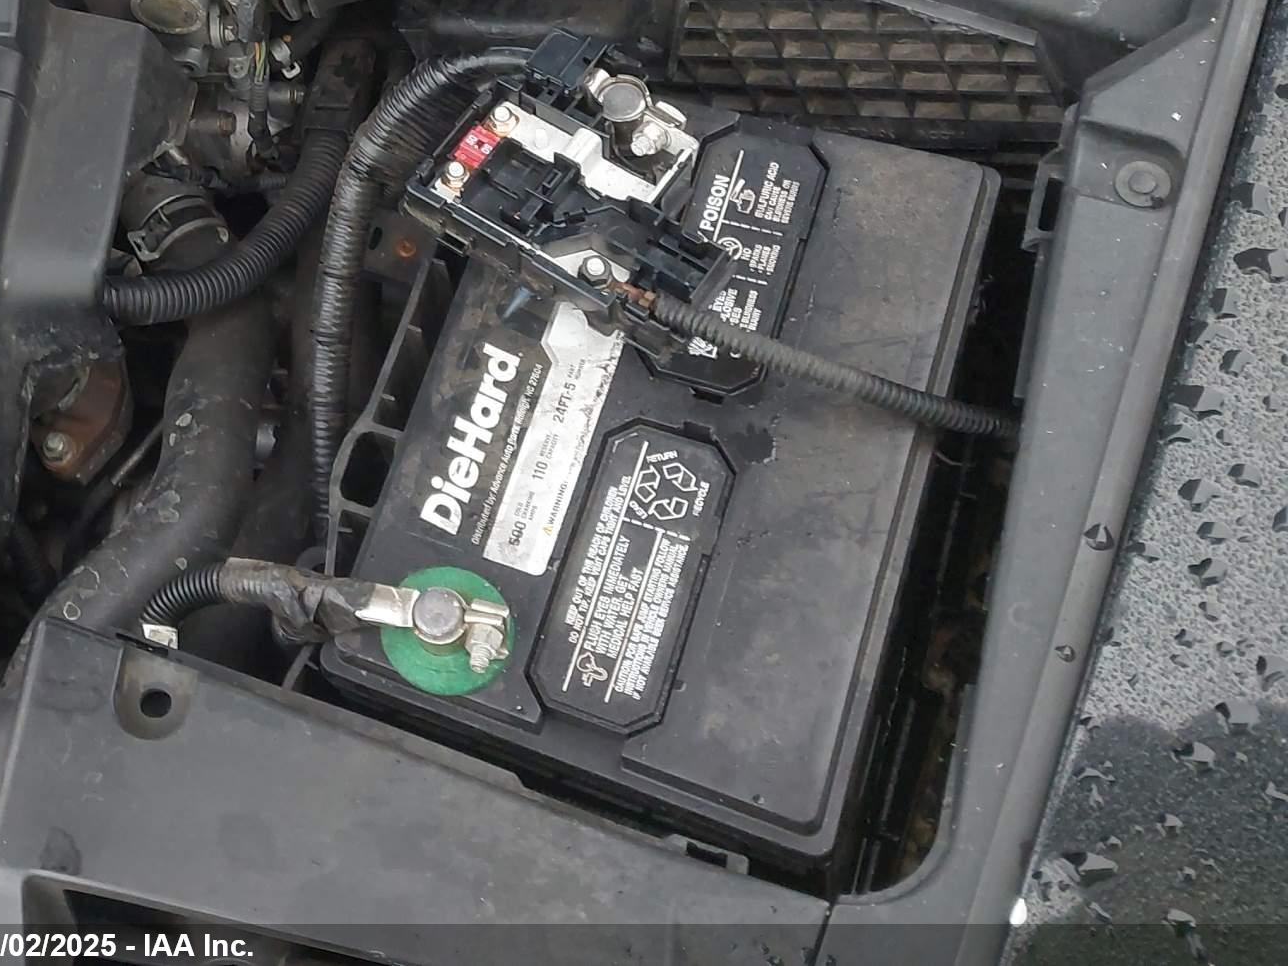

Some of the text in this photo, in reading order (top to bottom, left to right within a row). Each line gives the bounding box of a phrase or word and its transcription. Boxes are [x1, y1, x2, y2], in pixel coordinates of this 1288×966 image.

[766, 162, 779, 181] ACID
[741, 248, 752, 260] NO
[420, 343, 522, 535] DieHard
[471, 503, 491, 544] Distributed
[490, 462, 507, 493] Advance
[501, 444, 514, 463] Auto
[524, 385, 534, 396] NC
[532, 461, 548, 479] 110
[617, 476, 631, 496] LEVEL
[600, 486, 618, 521] CHILDREN
[612, 497, 624, 513] AND
[692, 481, 709, 516] RECYCLE
[604, 512, 618, 534] TIGHT
[587, 534, 603, 559] REACH
[597, 536, 610, 555] CAPS
[654, 538, 670, 568] FOLLOW
[581, 558, 594, 574] THE
[590, 556, 603, 575] VENT
[578, 575, 588, 588] OF
[584, 576, 596, 596] KEEP
[643, 568, 662, 602] STARTING
[572, 587, 584, 604] OUT
[583, 535, 630, 651] FLUSH EYES IMMEDIATELY
[657, 587, 675, 617] SERVICE
[565, 604, 578, 625] KEEP
[573, 613, 584, 631] NOT
[595, 630, 612, 654] WITH
[615, 574, 629, 593] GET
[606, 567, 643, 658] MEDICAL HELP FAST
[637, 602, 652, 625] JUMP
[568, 631, 579, 643] DO
[630, 623, 644, 642] SAFE
[621, 643, 650, 695] INSTRUCTIONS
[642, 604, 662, 634] VEHICLE
[625, 642, 639, 659] FOR
[639, 636, 659, 675] AVAILABLE
[634, 674, 647, 691] NOT
